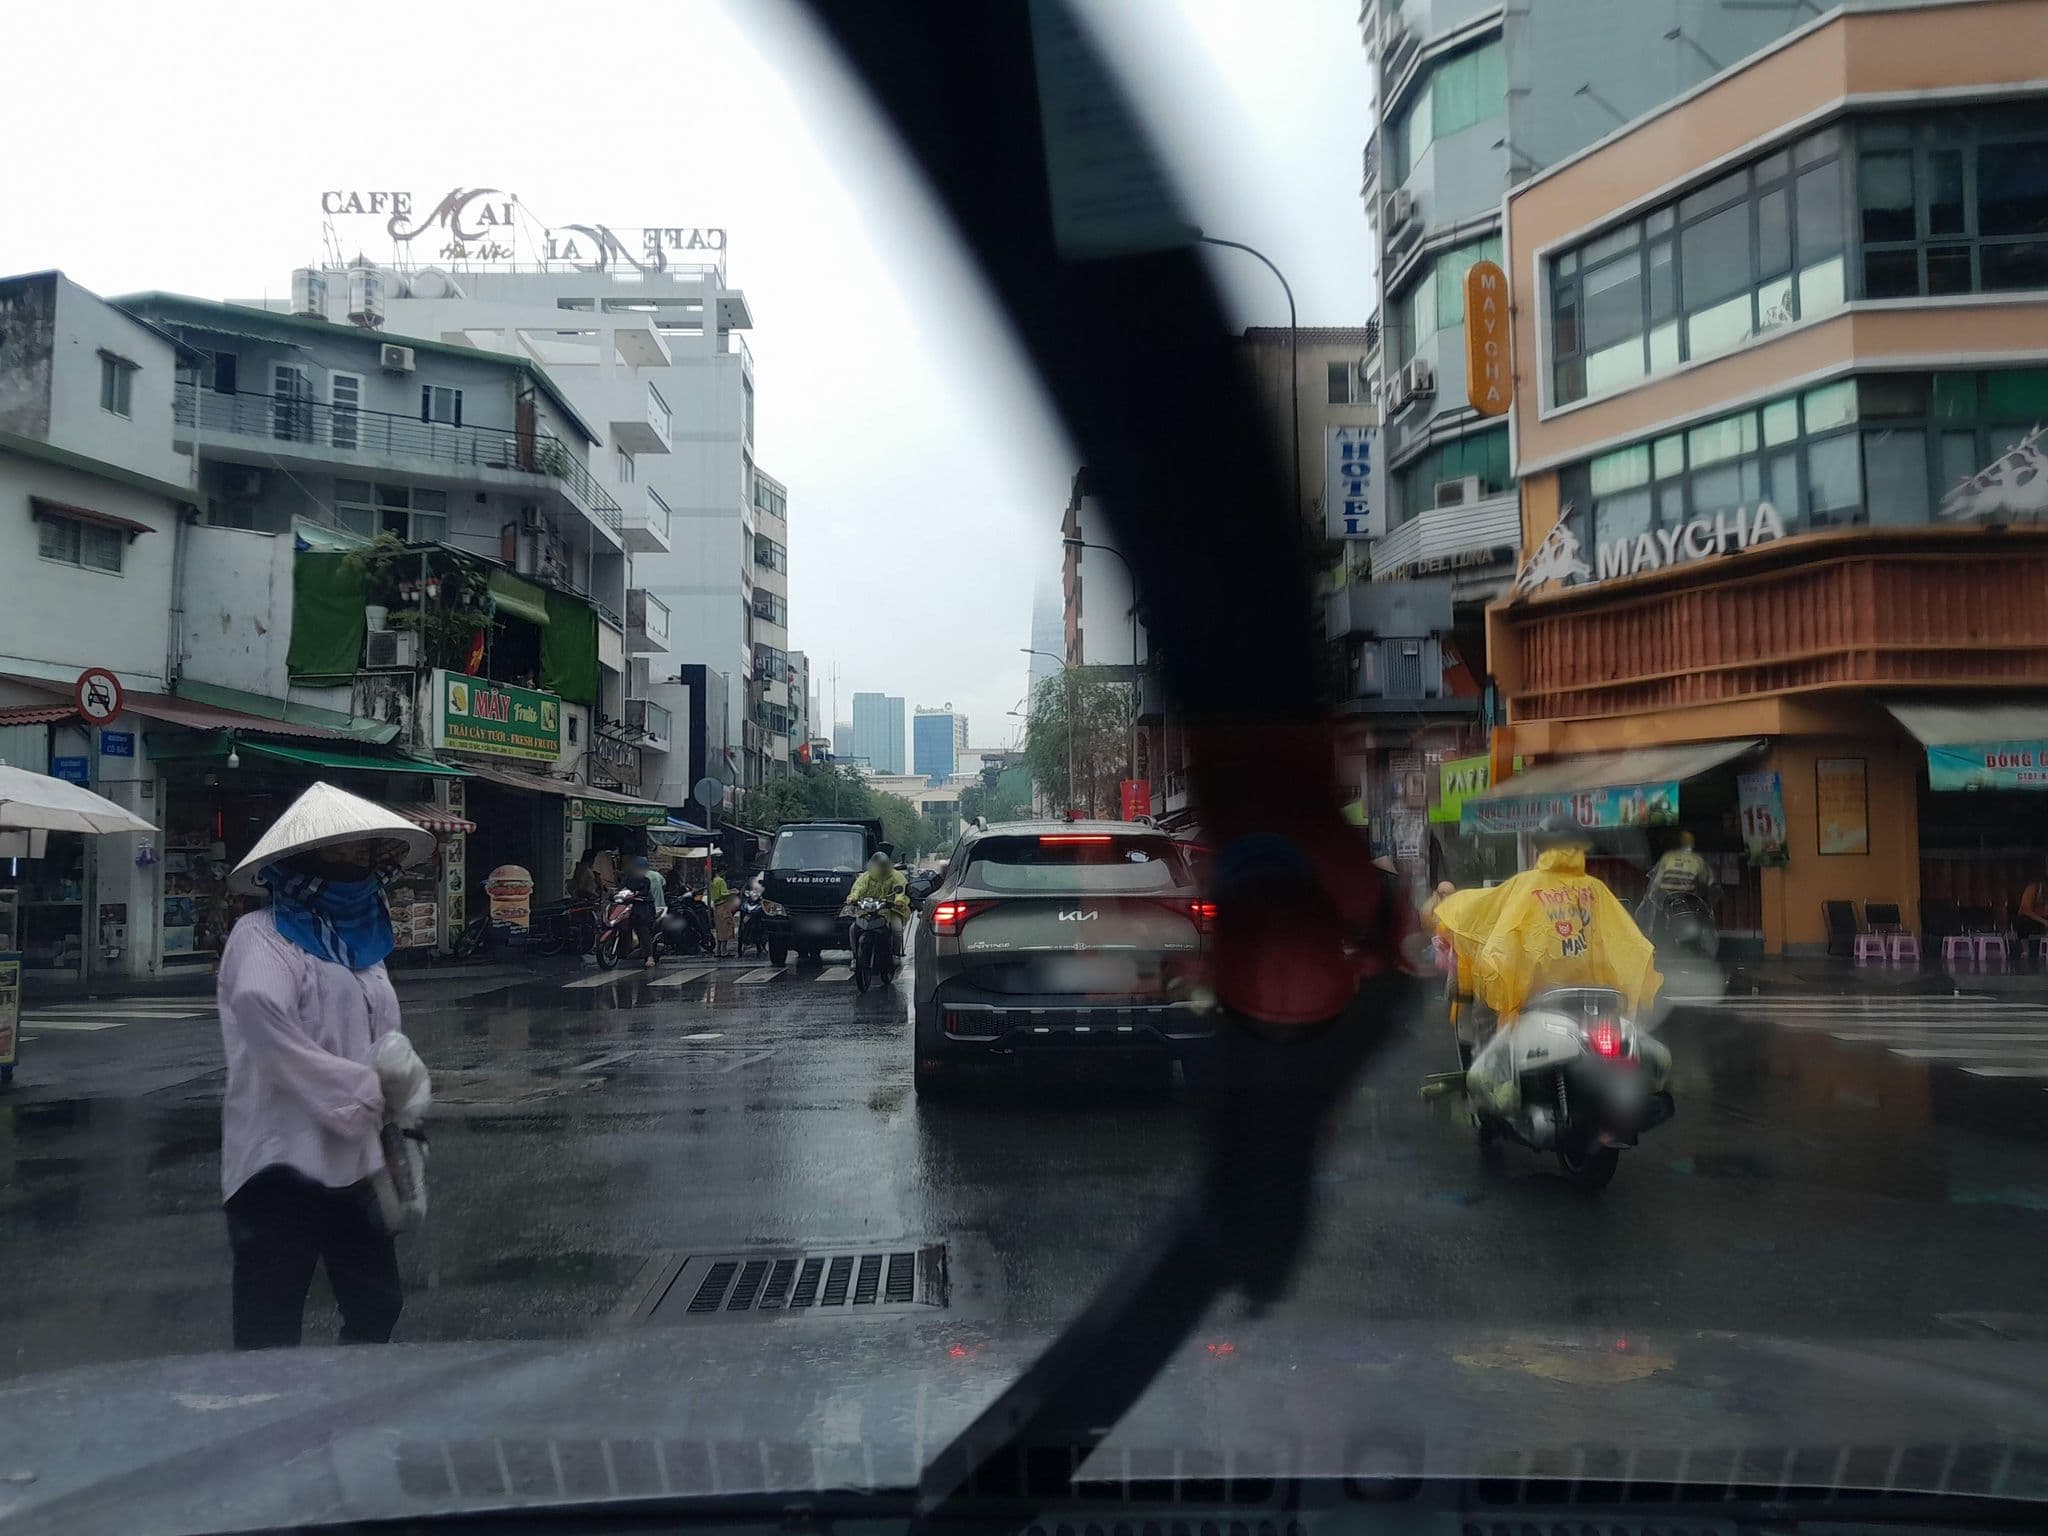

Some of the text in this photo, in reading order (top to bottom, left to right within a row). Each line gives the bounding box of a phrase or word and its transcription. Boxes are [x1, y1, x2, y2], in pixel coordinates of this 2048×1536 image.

[321, 191, 412, 215] CAFE
[1341, 443, 1371, 535] HOTEL
[1597, 500, 1786, 581] MAYCHA
[511, 733, 533, 747] FRESH
[1058, 911, 1098, 921] KIA
